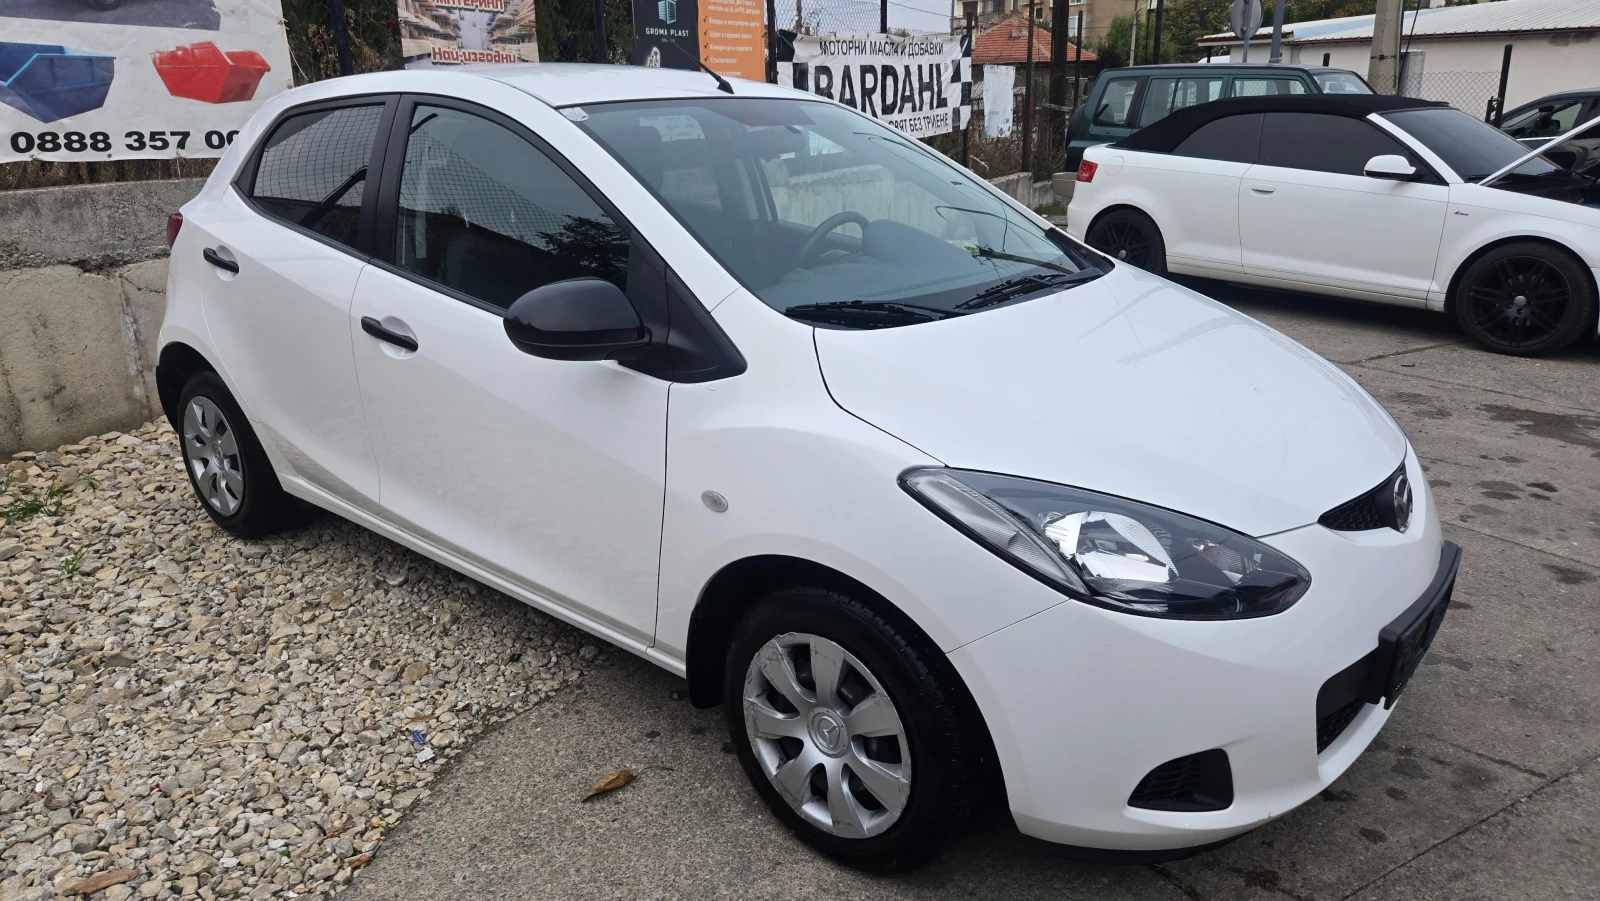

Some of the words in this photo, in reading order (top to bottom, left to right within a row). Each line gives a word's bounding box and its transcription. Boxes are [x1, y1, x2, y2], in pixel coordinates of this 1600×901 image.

[645, 27, 668, 36] GROMA
[670, 29, 689, 37] PLAST
[432, 46, 517, 64] Най-изгодни
[820, 40, 867, 56] МОТОРНИ
[869, 41, 899, 57] МАСЛА
[908, 42, 944, 59] ДОБАВКИ
[814, 63, 948, 119] BARDAHL
[909, 117, 923, 132] БЕЗ
[923, 112, 948, 130] ТРИЕНЕ
[10, 131, 112, 153] 0888
[124, 131, 191, 151] 357
